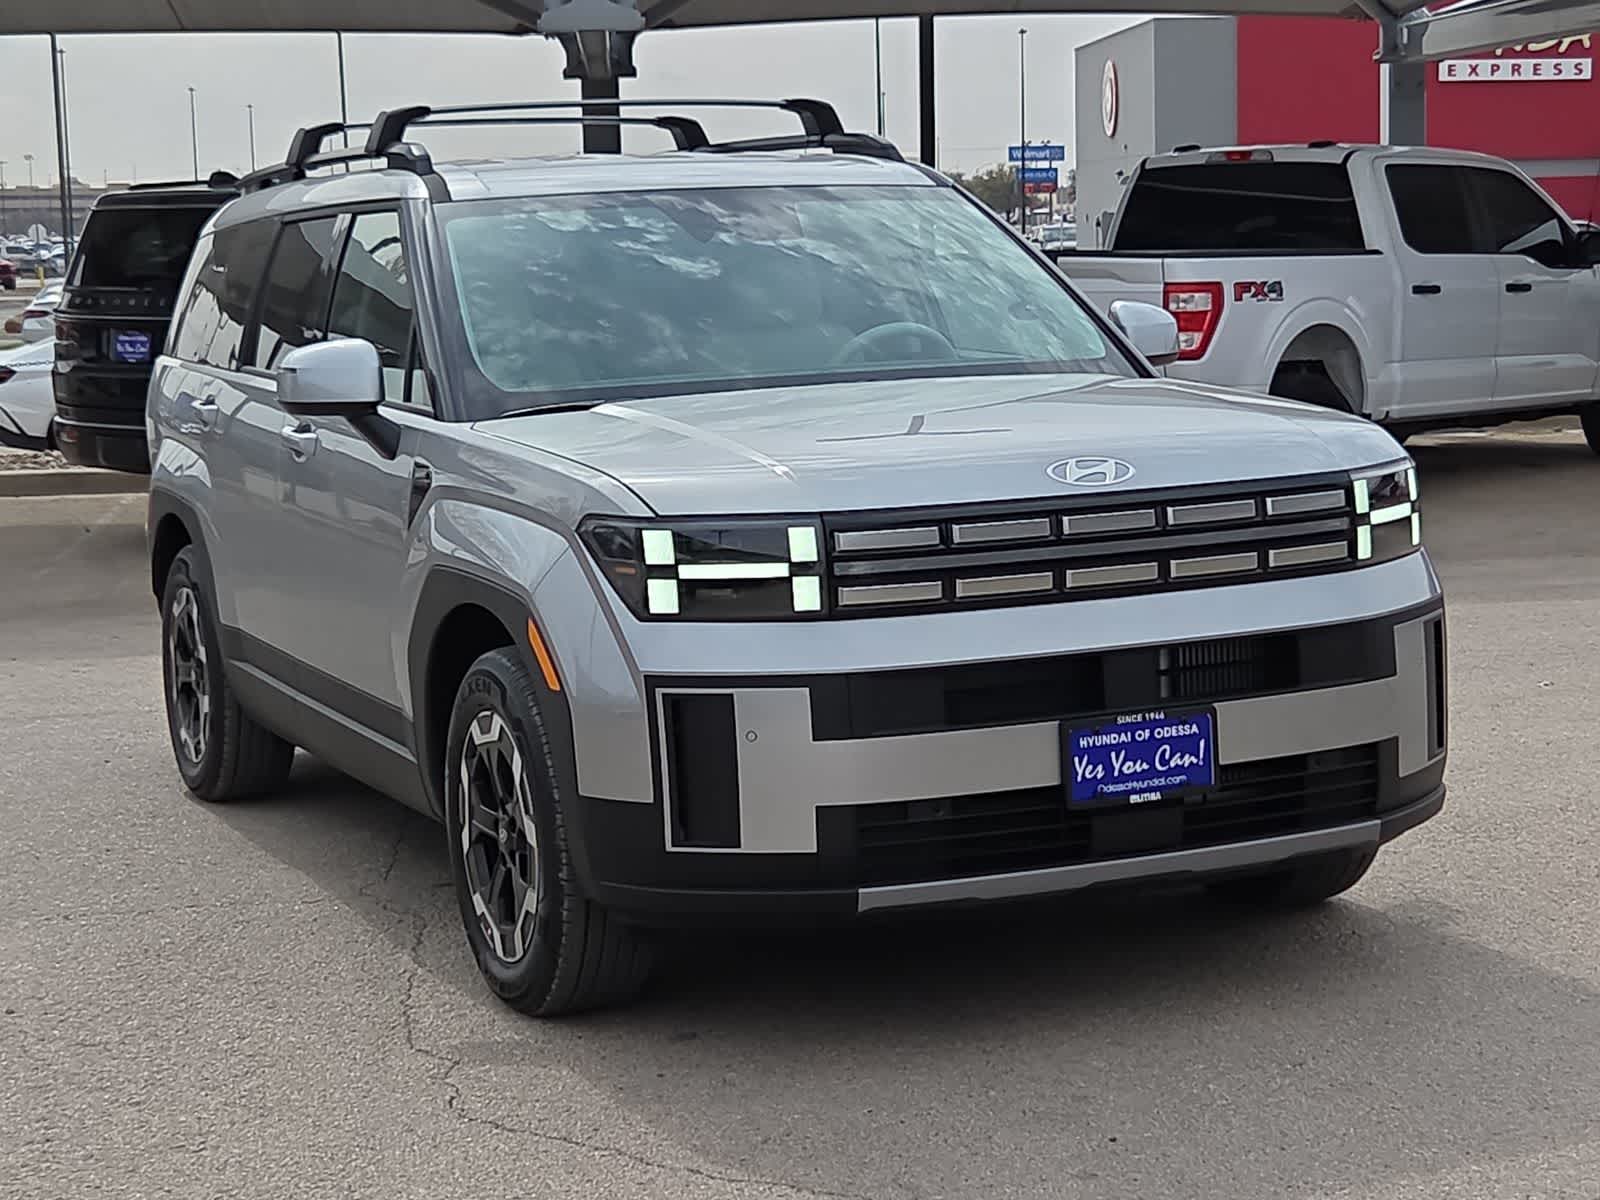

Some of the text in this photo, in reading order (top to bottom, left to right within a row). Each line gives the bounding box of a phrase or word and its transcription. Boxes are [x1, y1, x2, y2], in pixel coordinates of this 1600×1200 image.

[1447, 63, 1584, 77] EXPRESS
[1233, 280, 1284, 302] FX4
[1116, 714, 1143, 725] SINCE
[1079, 723, 1200, 749] HYUNDAI OF ODESSA
[1073, 738, 1205, 782] Yes You Can!
